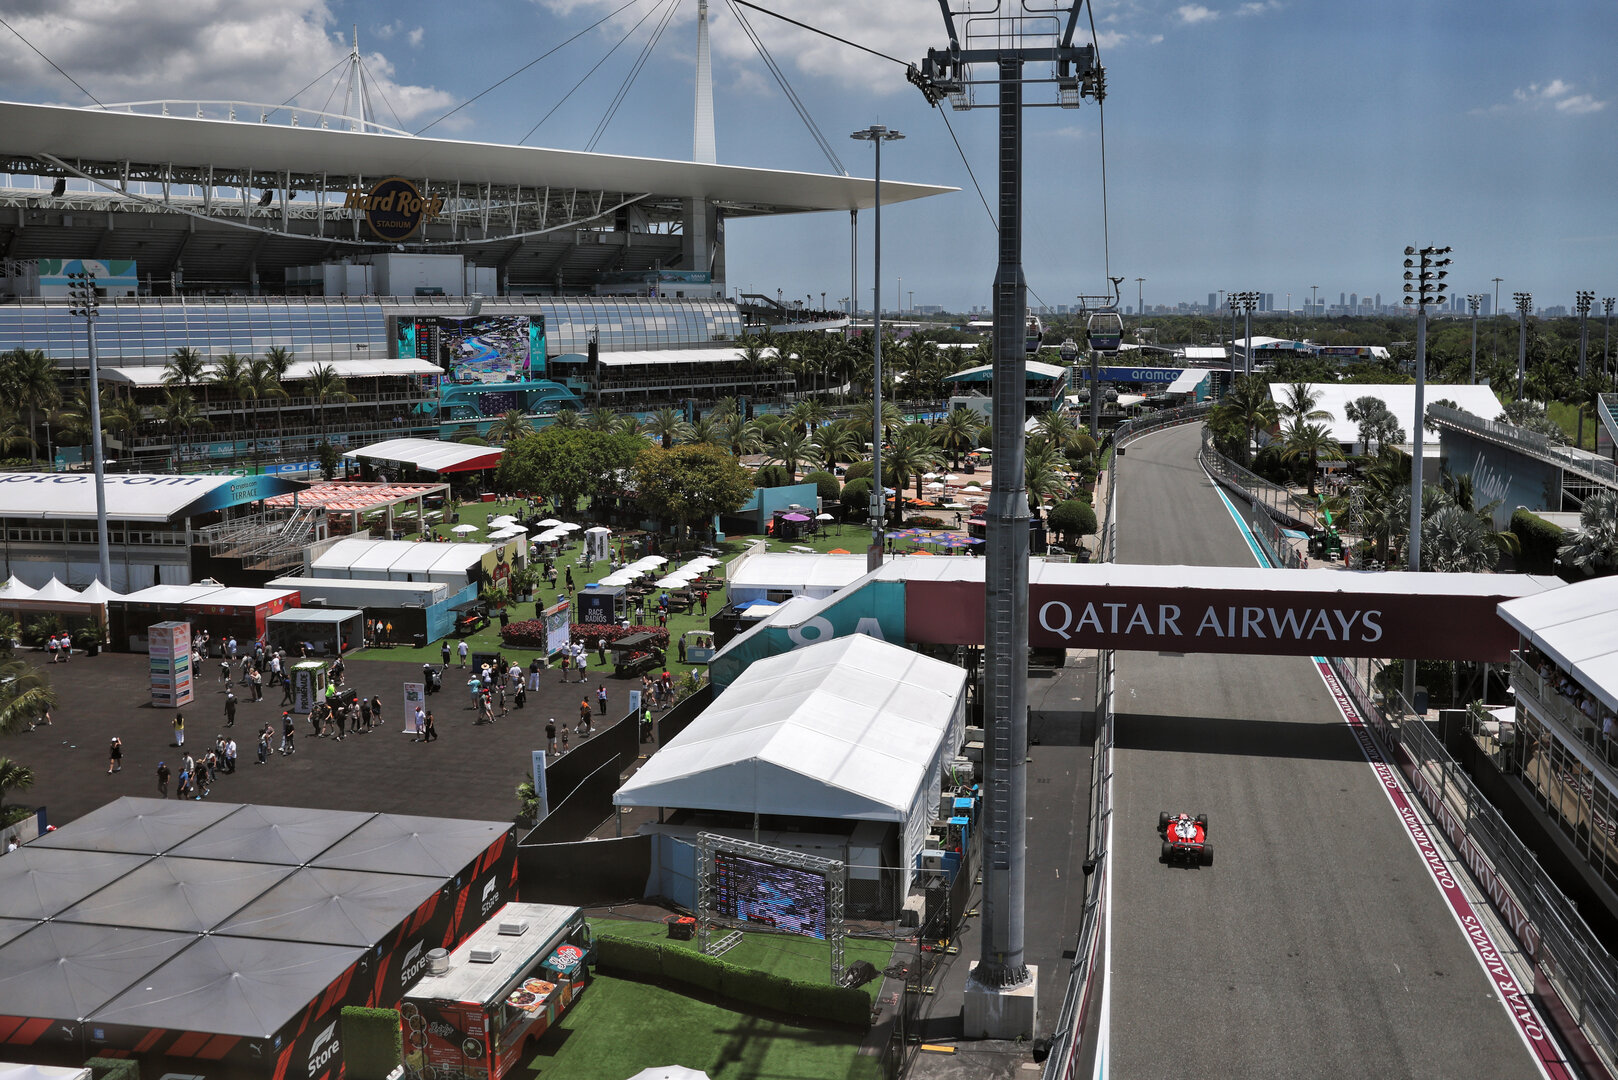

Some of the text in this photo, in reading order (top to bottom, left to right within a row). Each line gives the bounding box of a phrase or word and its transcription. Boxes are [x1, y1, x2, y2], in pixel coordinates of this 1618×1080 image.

[344, 188, 443, 223] Hard Rock
[376, 220, 411, 229] STADIUM
[1131, 370, 1179, 380] aramco
[235, 481, 257, 490] crypto.com
[1471, 451, 1513, 504] Miami
[231, 488, 257, 501] TERRACE
[585, 615, 607, 623] RADIOS
[588, 608, 604, 616] RACE
[1038, 601, 1384, 643] QATAR AIRWAYS
[1374, 761, 1398, 789] QATAR
[1400, 807, 1455, 889] QATAR AIRWAYS
[1412, 769, 1536, 956] QATAR AIRWAYS
[481, 875, 497, 903] F1
[482, 891, 499, 917] Store
[401, 938, 425, 971] F1
[1461, 915, 1544, 1041] QATAR AIRWAYS
[308, 1019, 337, 1060] F1
[308, 1039, 340, 1079] Store
